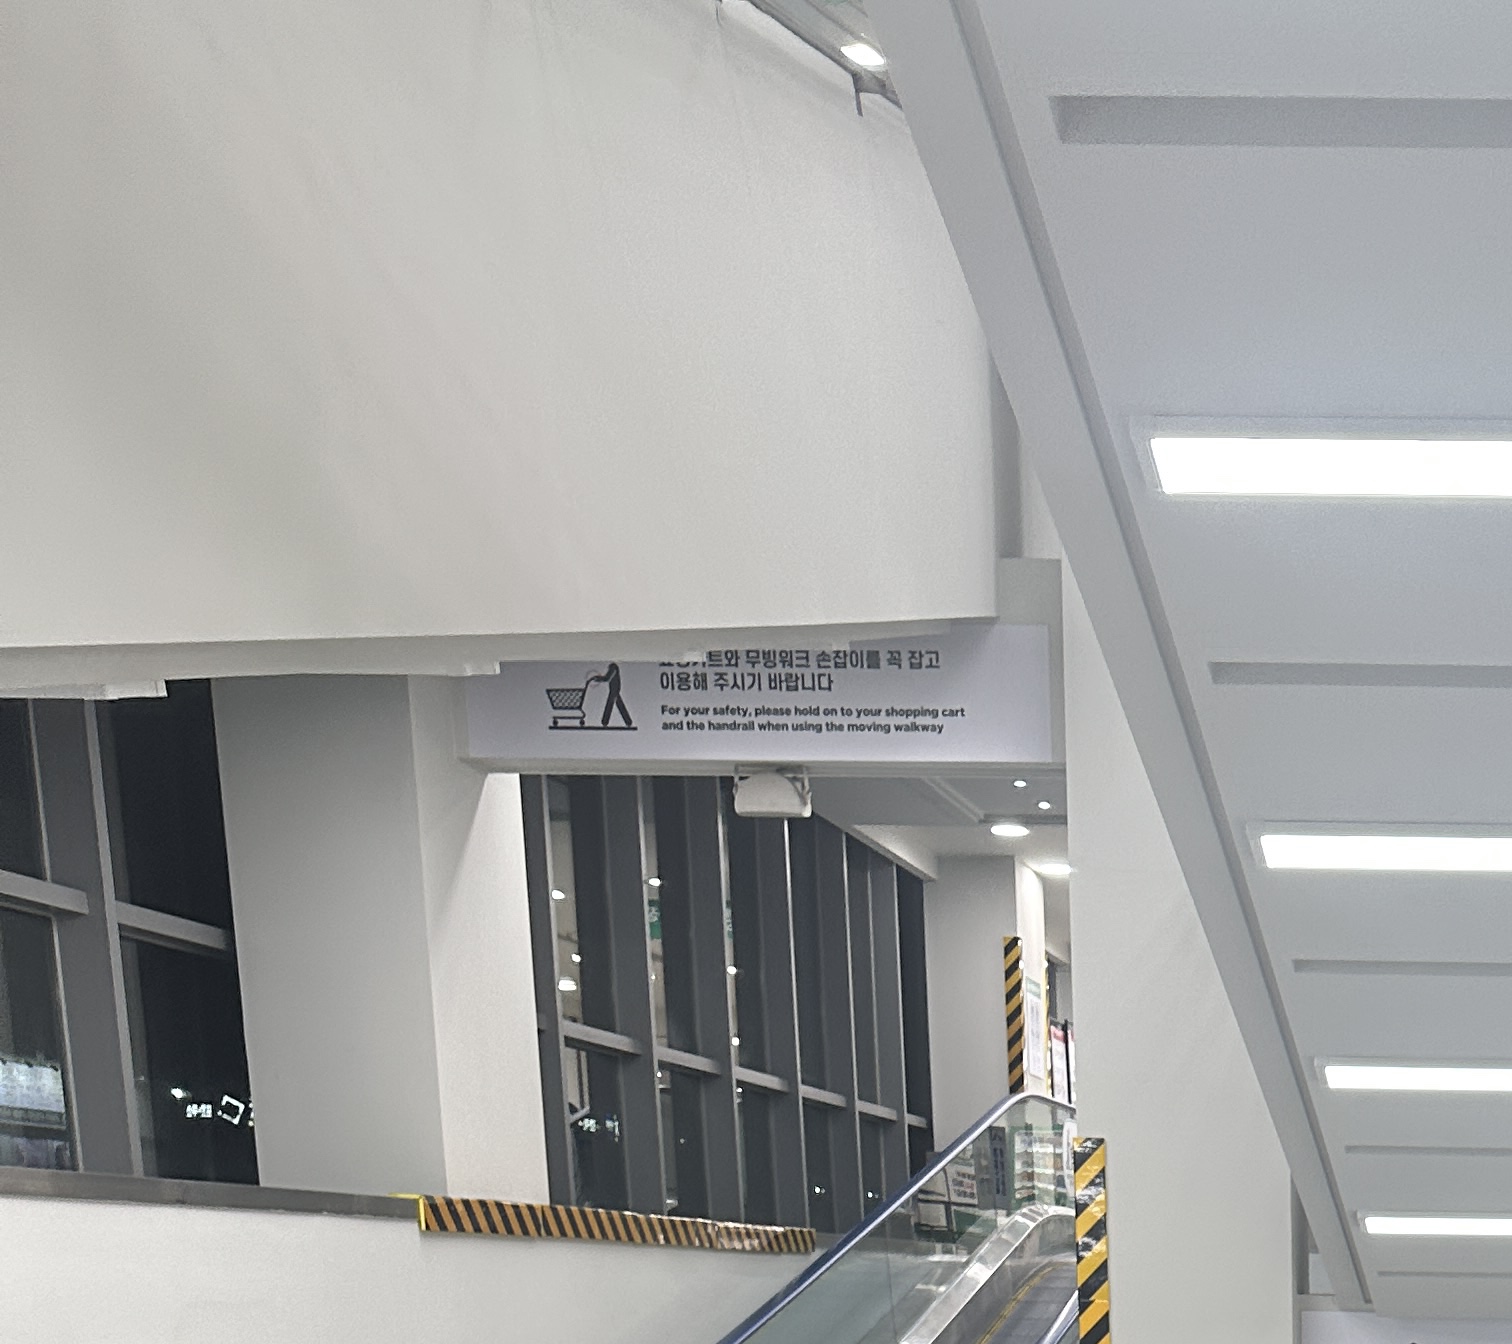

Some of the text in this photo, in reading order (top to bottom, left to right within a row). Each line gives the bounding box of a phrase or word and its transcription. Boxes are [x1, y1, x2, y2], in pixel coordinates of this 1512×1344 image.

[745, 650, 811, 669] 무빙워크
[816, 650, 881, 669] 손잡이를
[887, 650, 902, 669] 꼭
[908, 650, 940, 669] 잡고
[660, 671, 834, 692] 이용해 주시기 바랍니다
[661, 705, 965, 719] For your safety, please hold on to your shopping cart
[662, 721, 944, 735] and the handrail when using the moving walkway
